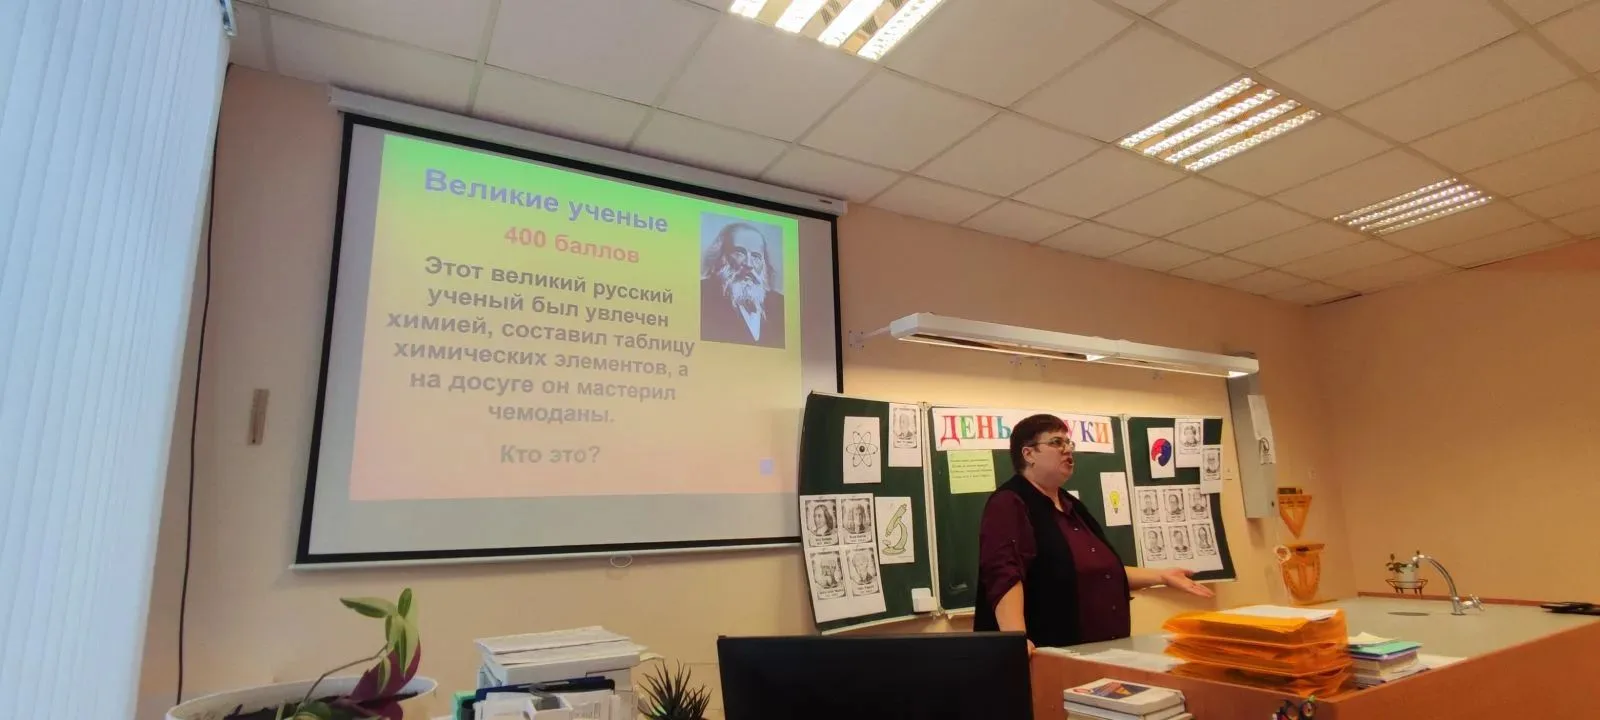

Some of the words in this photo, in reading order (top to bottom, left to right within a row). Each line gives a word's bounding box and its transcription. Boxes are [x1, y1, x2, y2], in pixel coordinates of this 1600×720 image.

[424, 168, 559, 213] Великие
[568, 199, 669, 233] ученые
[504, 226, 546, 248] 400
[555, 234, 640, 264] баллов
[424, 255, 483, 280] Этот
[490, 266, 587, 293] великий
[593, 281, 674, 304] русский
[427, 286, 524, 311] ученый
[531, 296, 579, 317] был
[585, 304, 670, 328] увлечен
[386, 311, 493, 339] химией,
[501, 322, 607, 346] составил
[612, 332, 695, 357] таблицу
[393, 341, 547, 367] химических
[554, 352, 673, 378] элементов,
[678, 364, 689, 377] а
[409, 372, 441, 389] на
[448, 374, 534, 397] досуге
[542, 379, 569, 394] он
[577, 381, 677, 402] мастерил
[488, 404, 615, 424] чемоданы.
[940, 415, 1011, 447] ДЕНЬ
[1062, 418, 1110, 444] УКИ
[500, 444, 542, 463] Кто
[549, 446, 601, 463] это?
